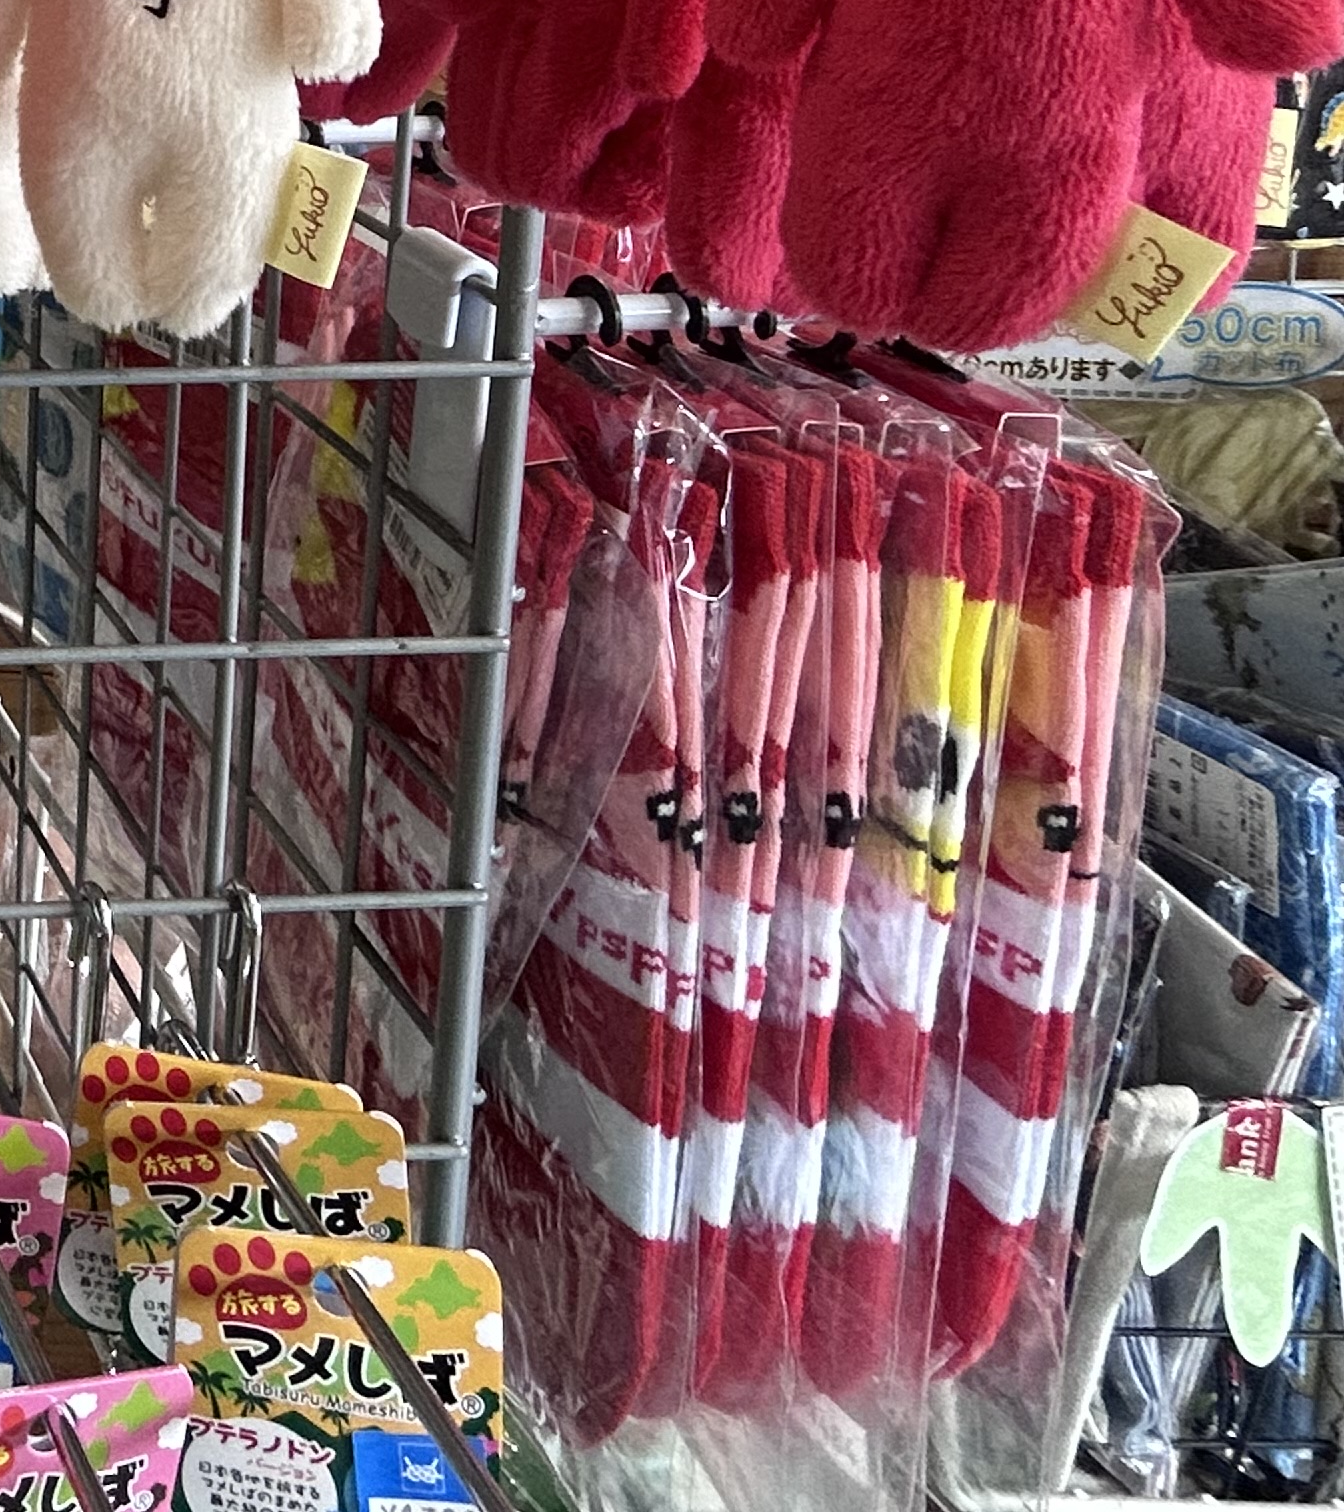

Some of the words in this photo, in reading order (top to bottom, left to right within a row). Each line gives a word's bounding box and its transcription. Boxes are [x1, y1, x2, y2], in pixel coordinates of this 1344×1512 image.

[143, 1153, 217, 1178] 旅する
[221, 1290, 302, 1317] 旅する
[242, 1379, 321, 1407] Tabisuru
